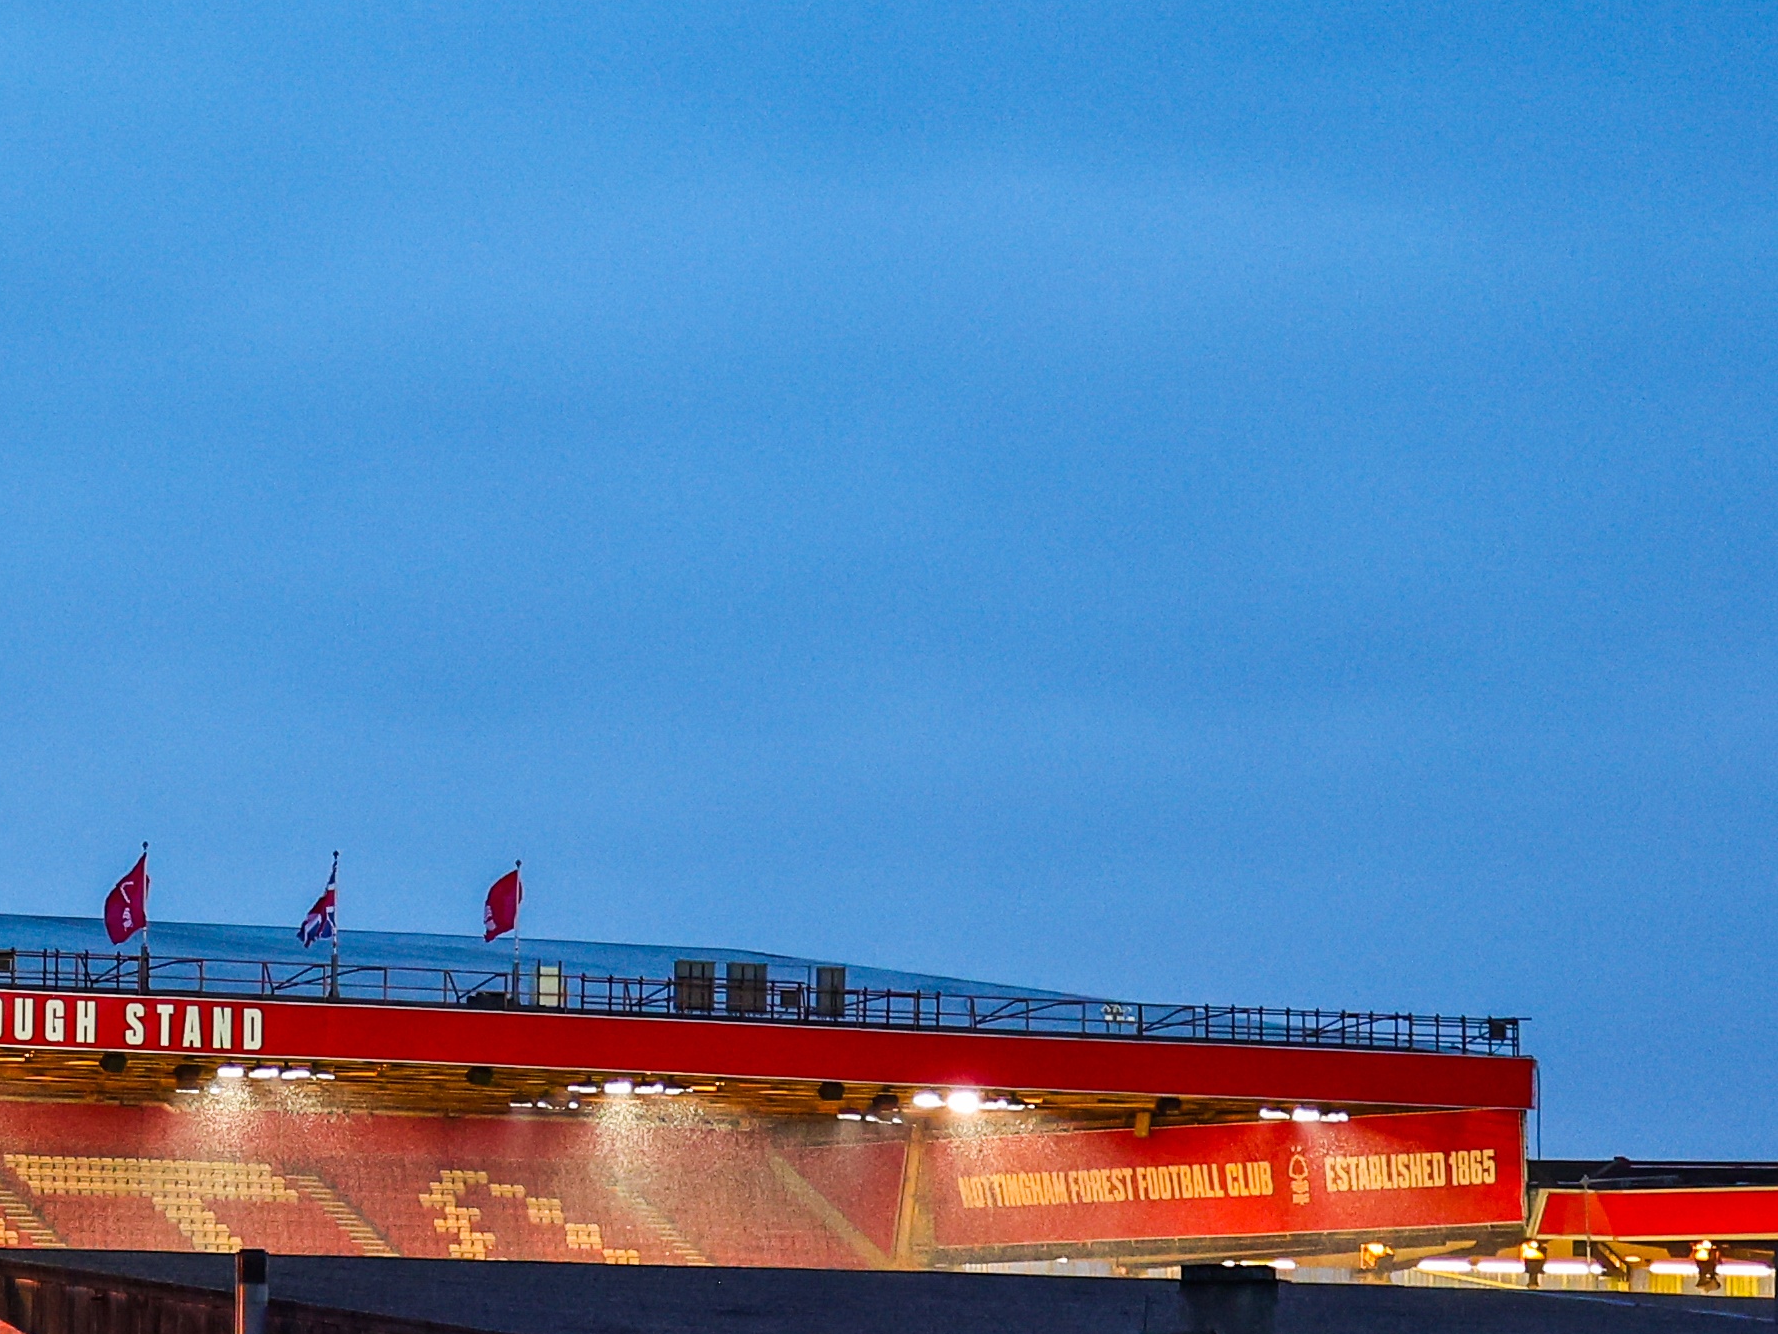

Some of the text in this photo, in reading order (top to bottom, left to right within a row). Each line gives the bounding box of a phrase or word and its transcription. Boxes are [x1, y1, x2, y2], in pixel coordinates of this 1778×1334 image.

[125, 1003, 263, 1051] STAND
[958, 1171, 1068, 1209] NOTTINGHAM
[1069, 1168, 1136, 1204] FOREST
[1139, 1163, 1225, 1200] FOOTBALL
[1225, 1161, 1274, 1197] CLUB
[1324, 1153, 1446, 1193] ESTABLISHED
[1448, 1149, 1497, 1186] 1865
